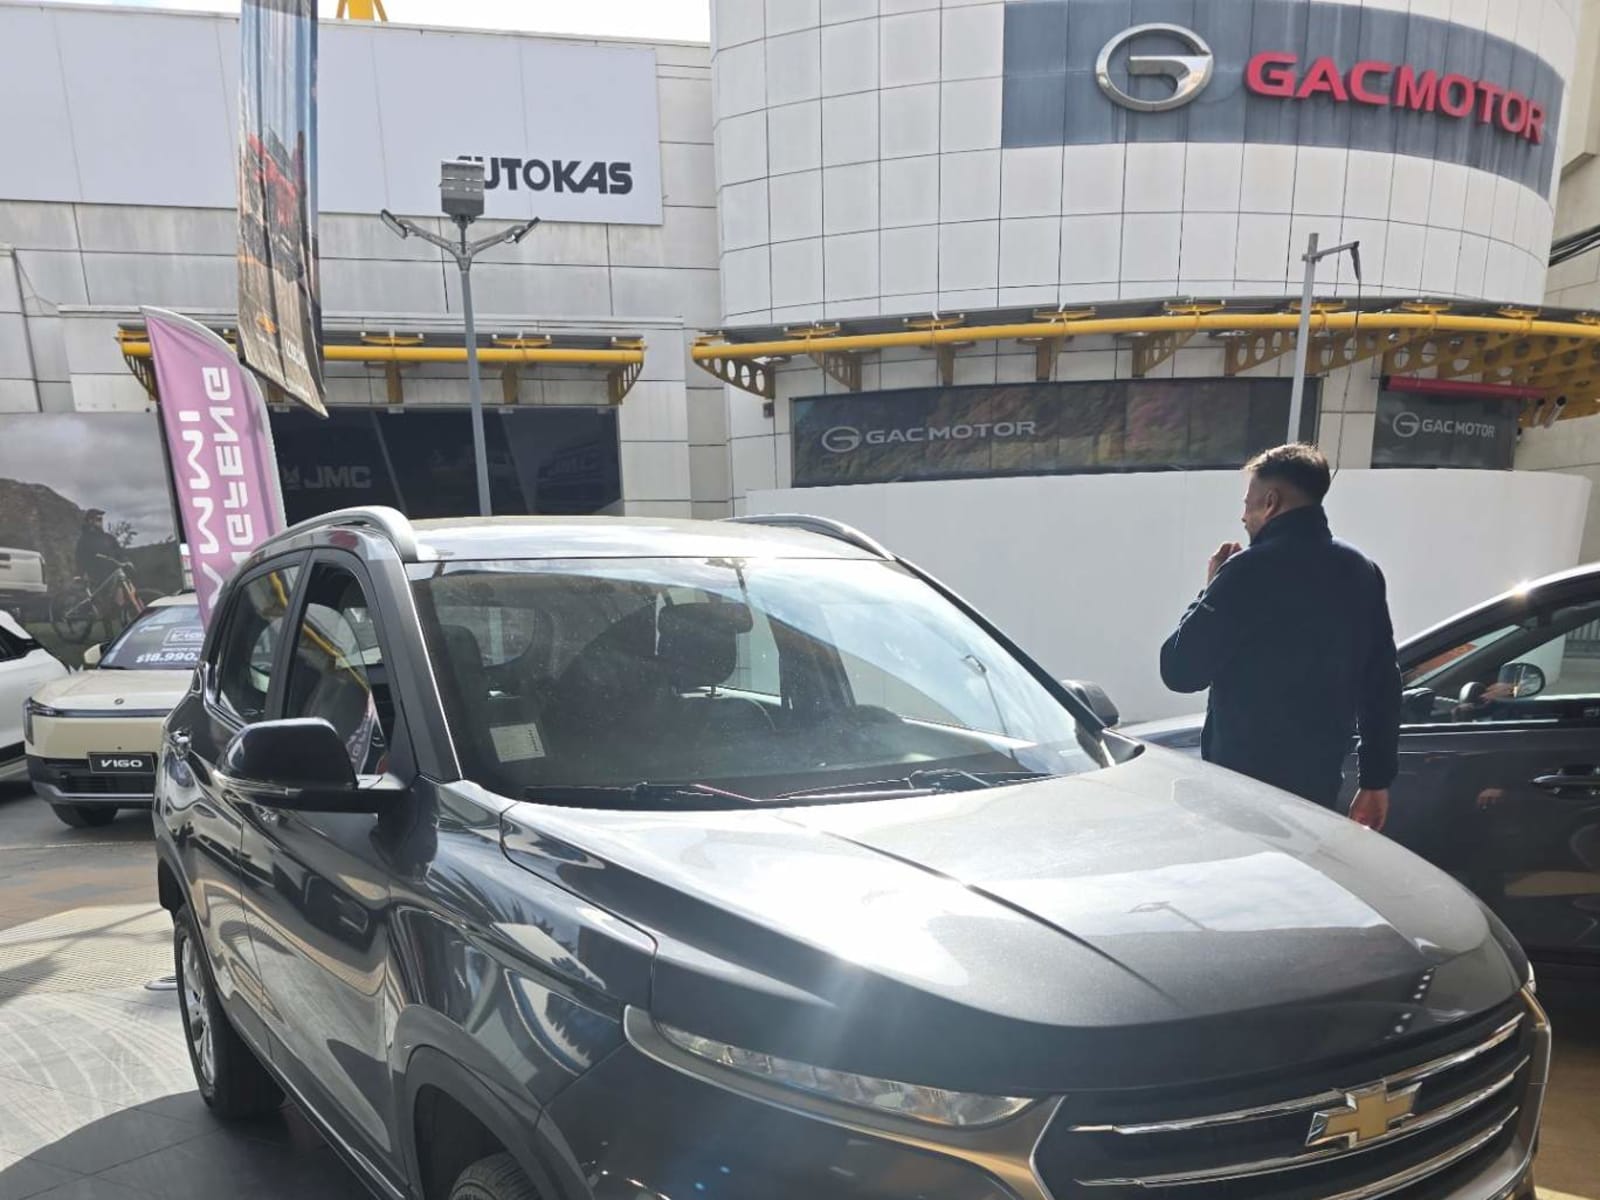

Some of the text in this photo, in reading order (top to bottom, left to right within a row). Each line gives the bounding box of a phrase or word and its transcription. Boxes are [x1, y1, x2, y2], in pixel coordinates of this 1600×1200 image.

[457, 155, 633, 195] UTOKAS
[866, 421, 1036, 444] GAC MOTOR
[304, 466, 372, 489] JMC
[101, 759, 143, 768] VIGO
